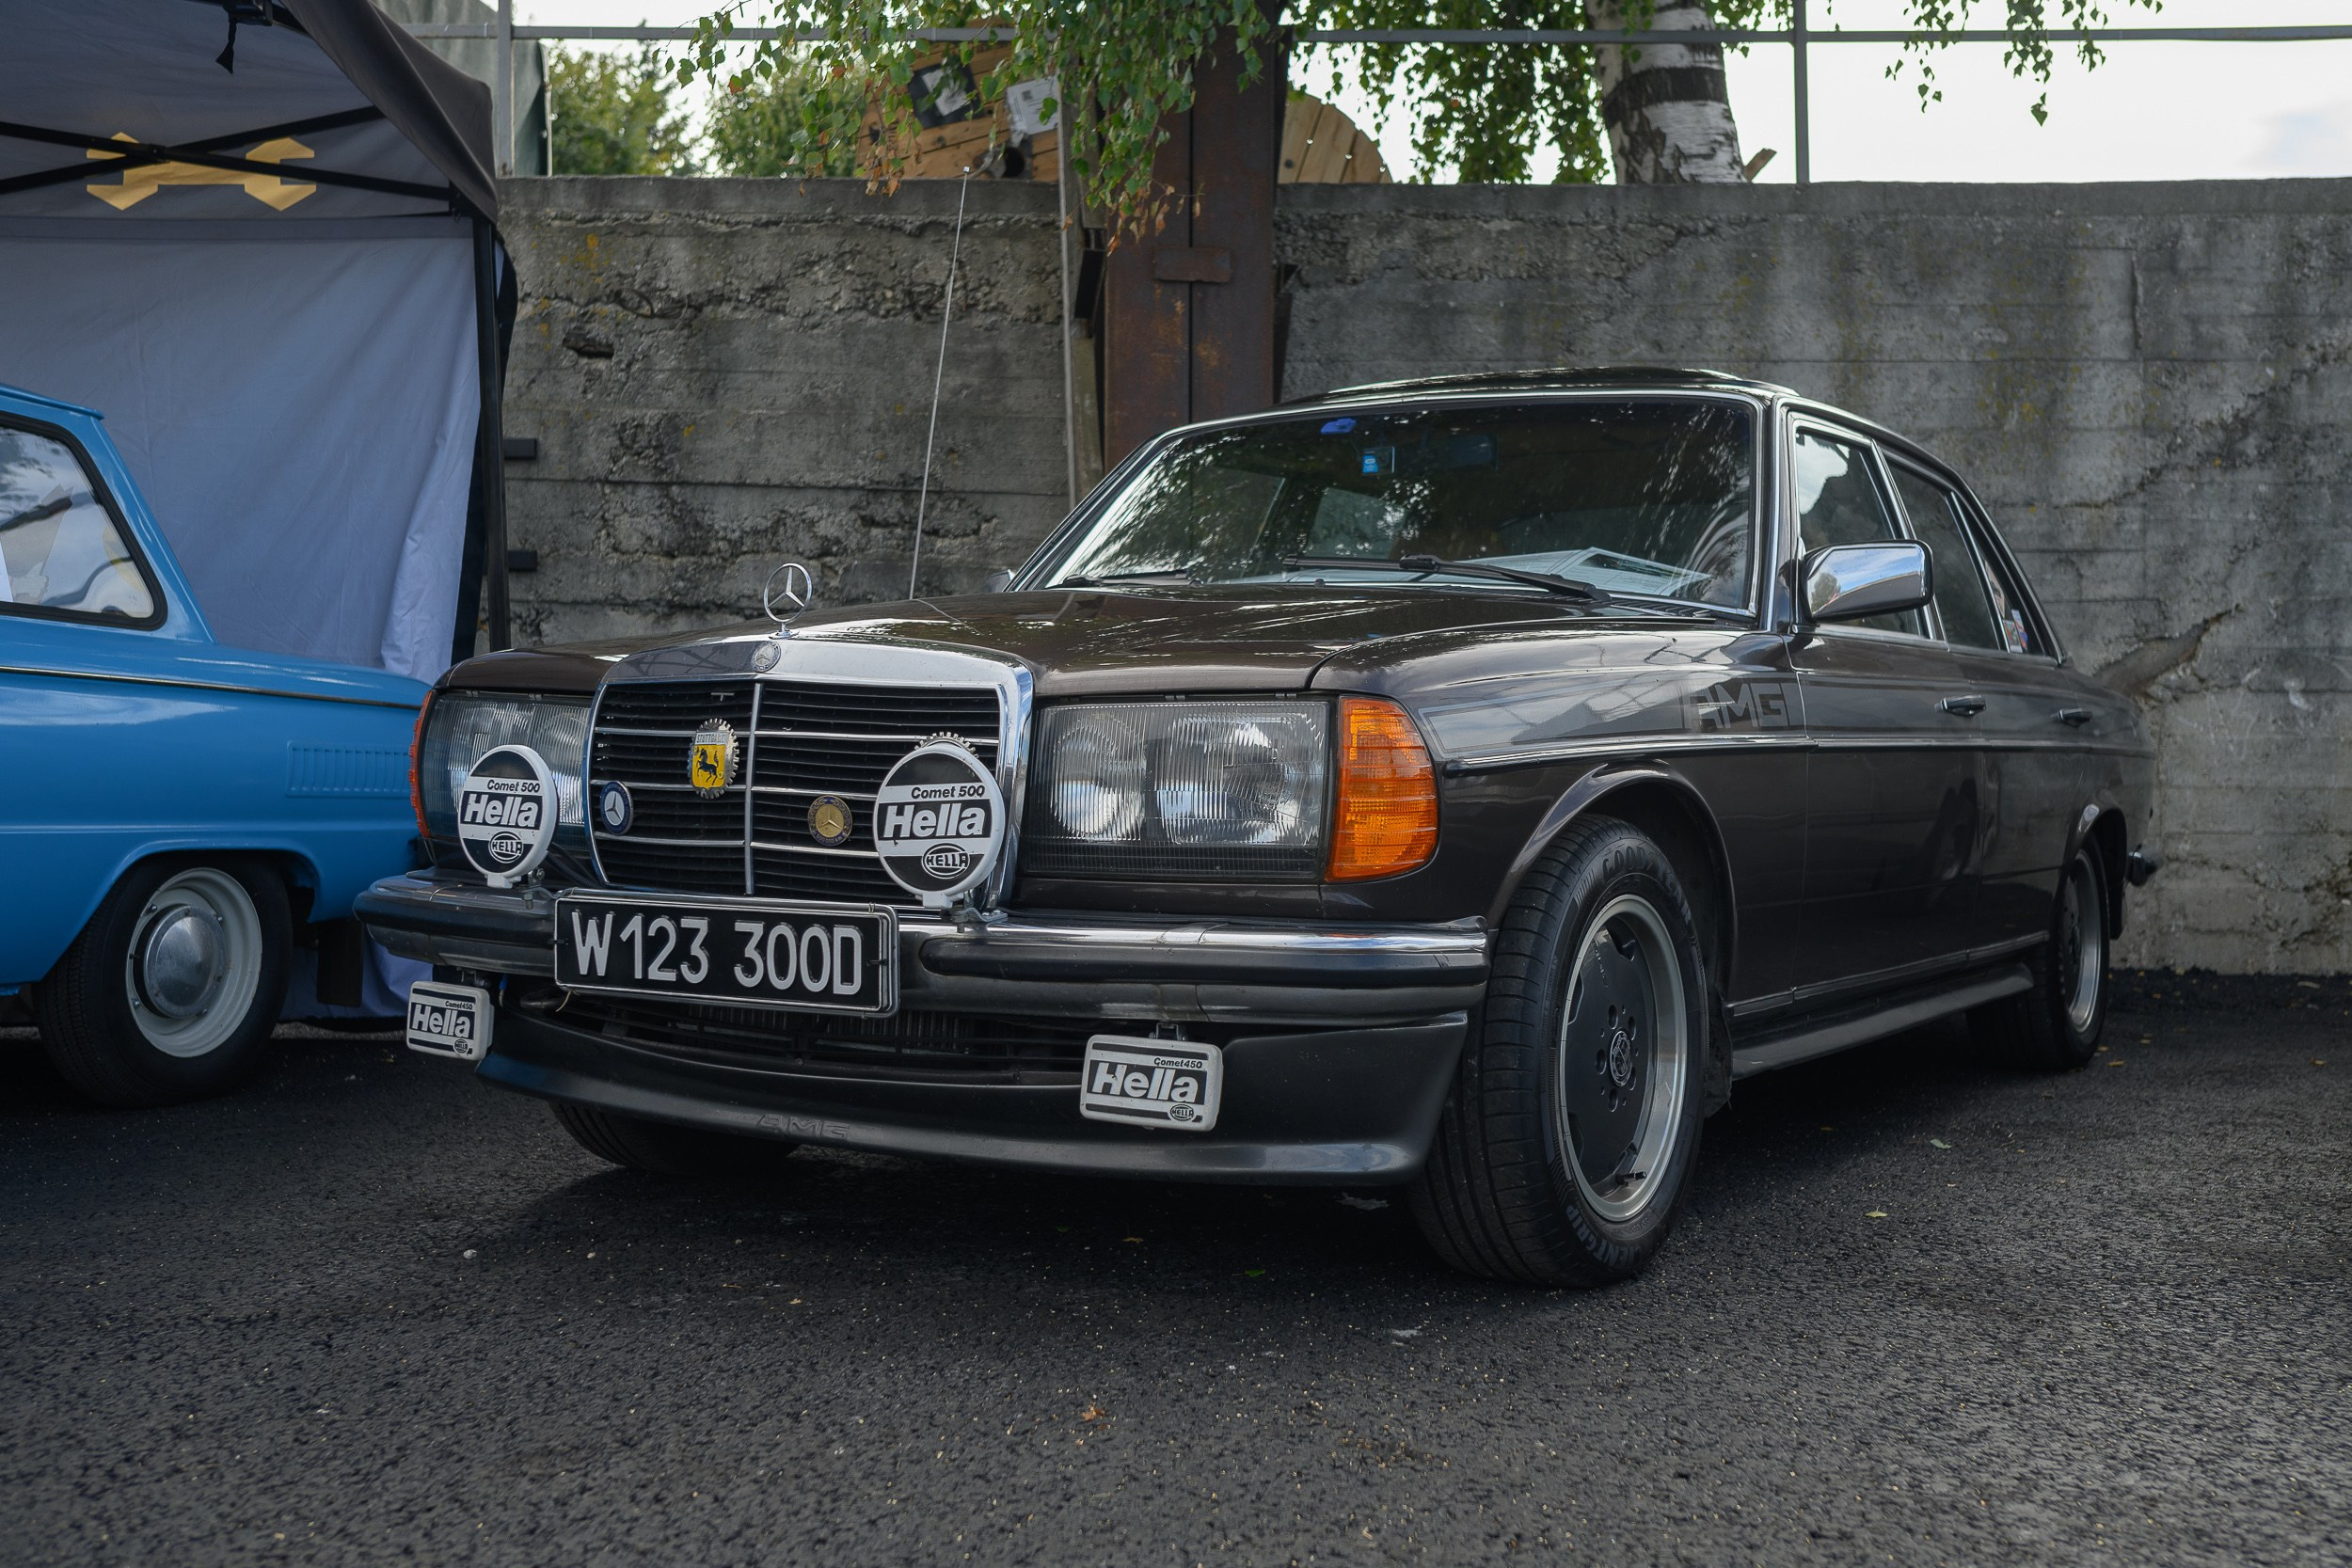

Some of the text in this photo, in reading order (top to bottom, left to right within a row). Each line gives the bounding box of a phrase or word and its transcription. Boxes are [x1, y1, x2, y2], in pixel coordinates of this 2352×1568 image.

[1682, 683, 1789, 729] AMG
[487, 779, 541, 793] Comet 500
[911, 784, 986, 800] Comet 500
[464, 793, 539, 828] Hella
[882, 802, 986, 838] Hella
[491, 841, 523, 854] HELLA
[926, 852, 969, 868] HELLA
[571, 909, 864, 995] W123 300D
[411, 1004, 471, 1038] Hella
[1091, 1062, 1199, 1103] Hella
[1170, 1108, 1195, 1117] HELLA
